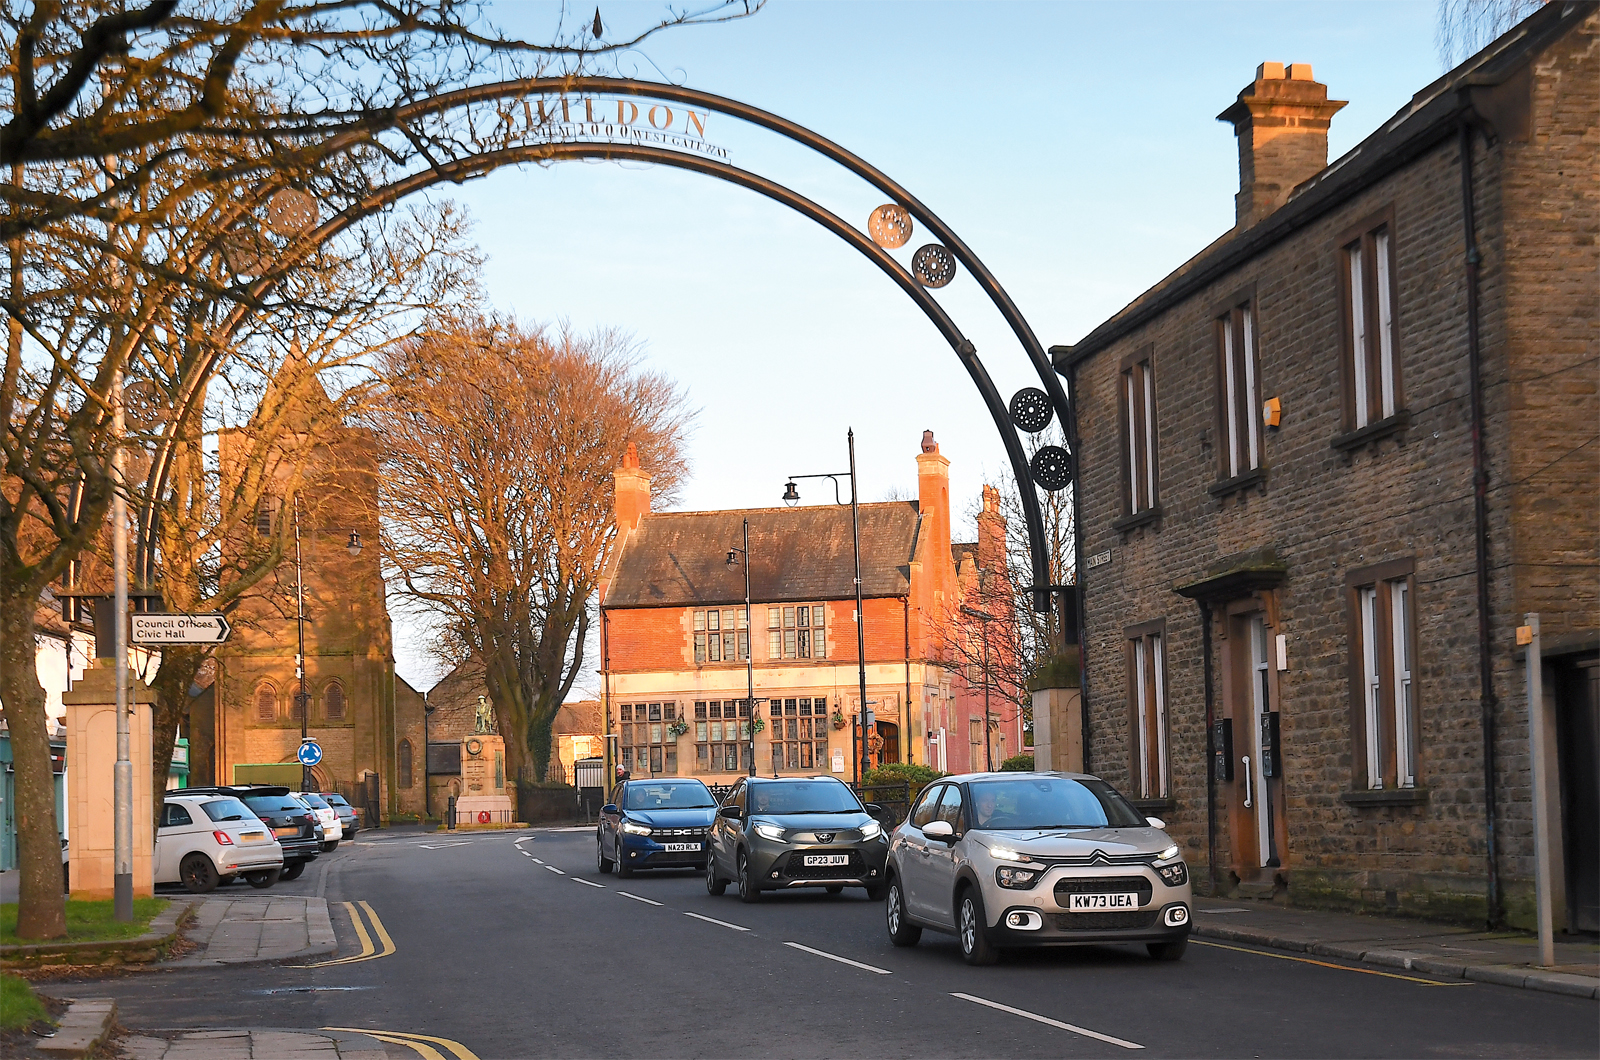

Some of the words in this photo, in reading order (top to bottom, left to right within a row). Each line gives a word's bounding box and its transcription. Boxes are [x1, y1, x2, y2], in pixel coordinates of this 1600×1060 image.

[497, 98, 707, 138] SHILDON
[578, 122, 628, 138] 2000
[633, 129, 667, 143] WEST
[671, 136, 729, 159] GATEWAY
[136, 619, 175, 629] Council
[177, 619, 213, 629] Offices
[136, 630, 162, 639] Civic
[165, 630, 186, 639] Hall
[807, 856, 829, 865] GP23
[830, 855, 845, 864] JUV
[1075, 895, 1107, 908] KW73
[1109, 894, 1132, 907] UEA
